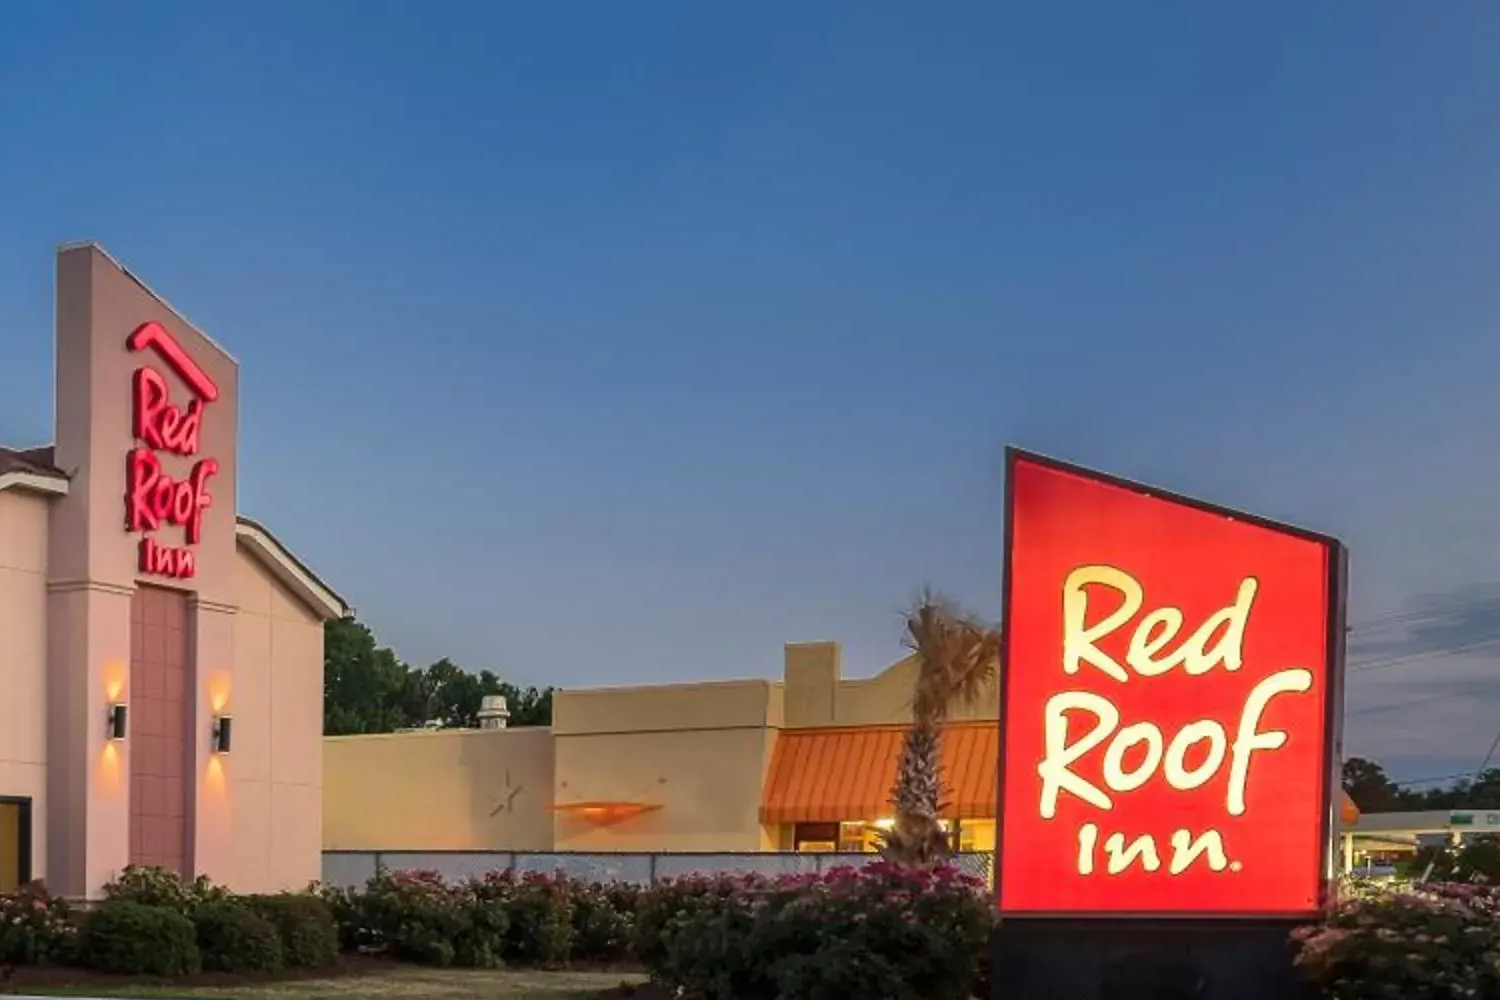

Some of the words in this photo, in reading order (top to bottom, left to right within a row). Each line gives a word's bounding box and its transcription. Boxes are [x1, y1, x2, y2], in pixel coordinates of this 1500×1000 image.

[132, 367, 205, 456] Red
[124, 449, 218, 543] Roof
[139, 538, 195, 577] Inn
[1063, 565, 1258, 682] Red
[1038, 669, 1312, 818] Roof
